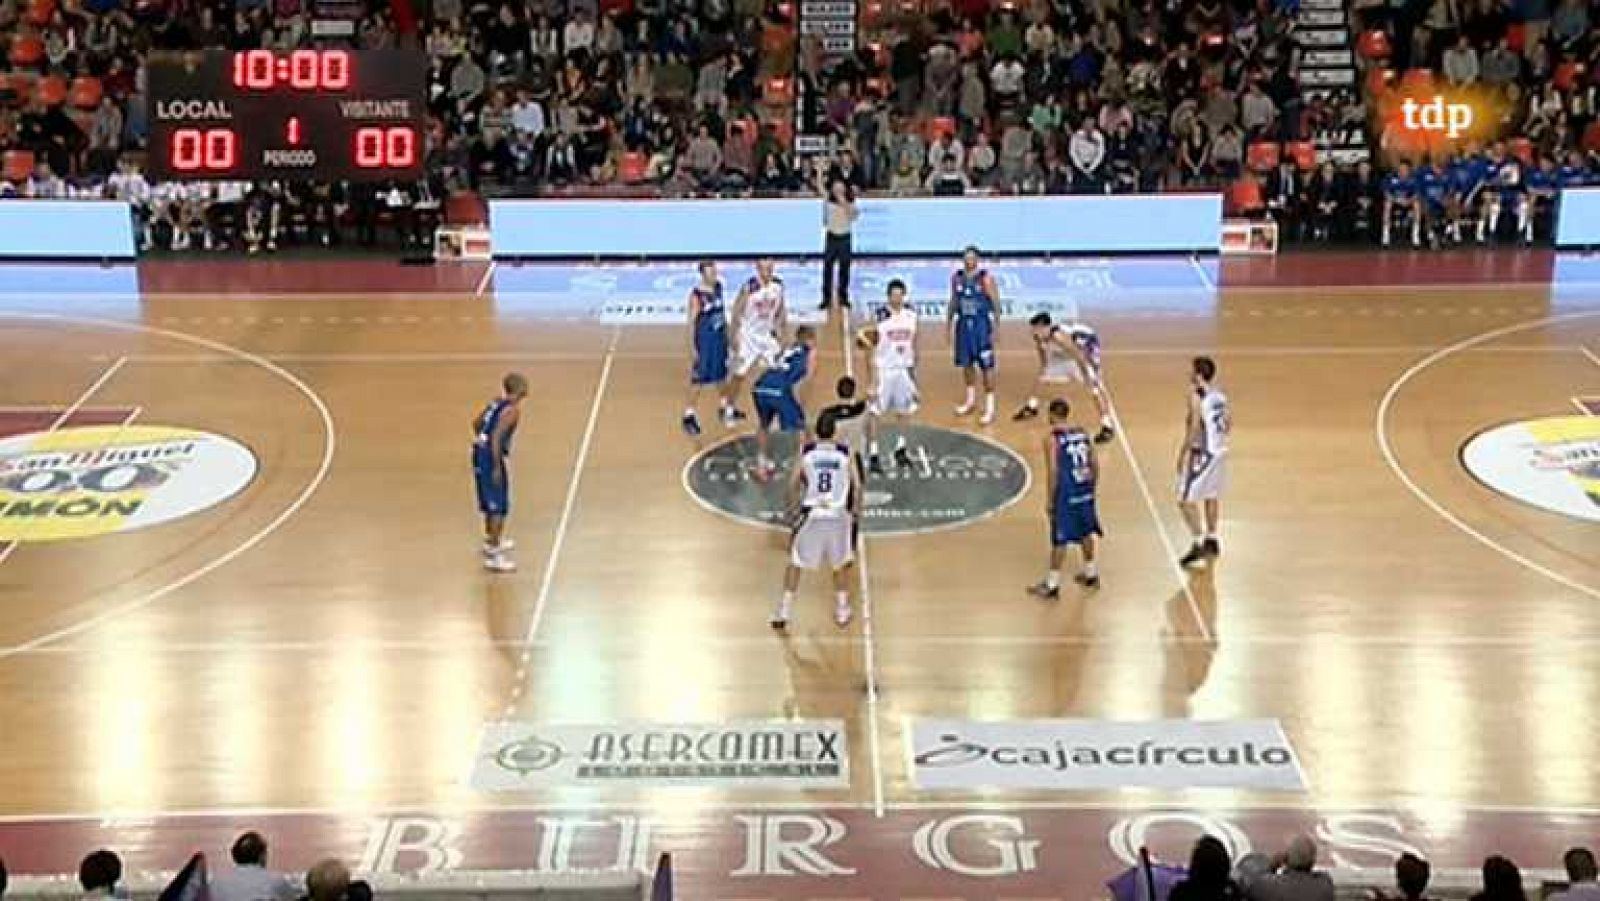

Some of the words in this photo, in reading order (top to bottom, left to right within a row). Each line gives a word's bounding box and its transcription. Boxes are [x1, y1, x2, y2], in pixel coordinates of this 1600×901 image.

[818, 472, 832, 493] 8
[583, 731, 838, 762] ASERCOMEX
[990, 740, 1292, 771] cajacírculo
[354, 812, 1428, 876] BURGOS
